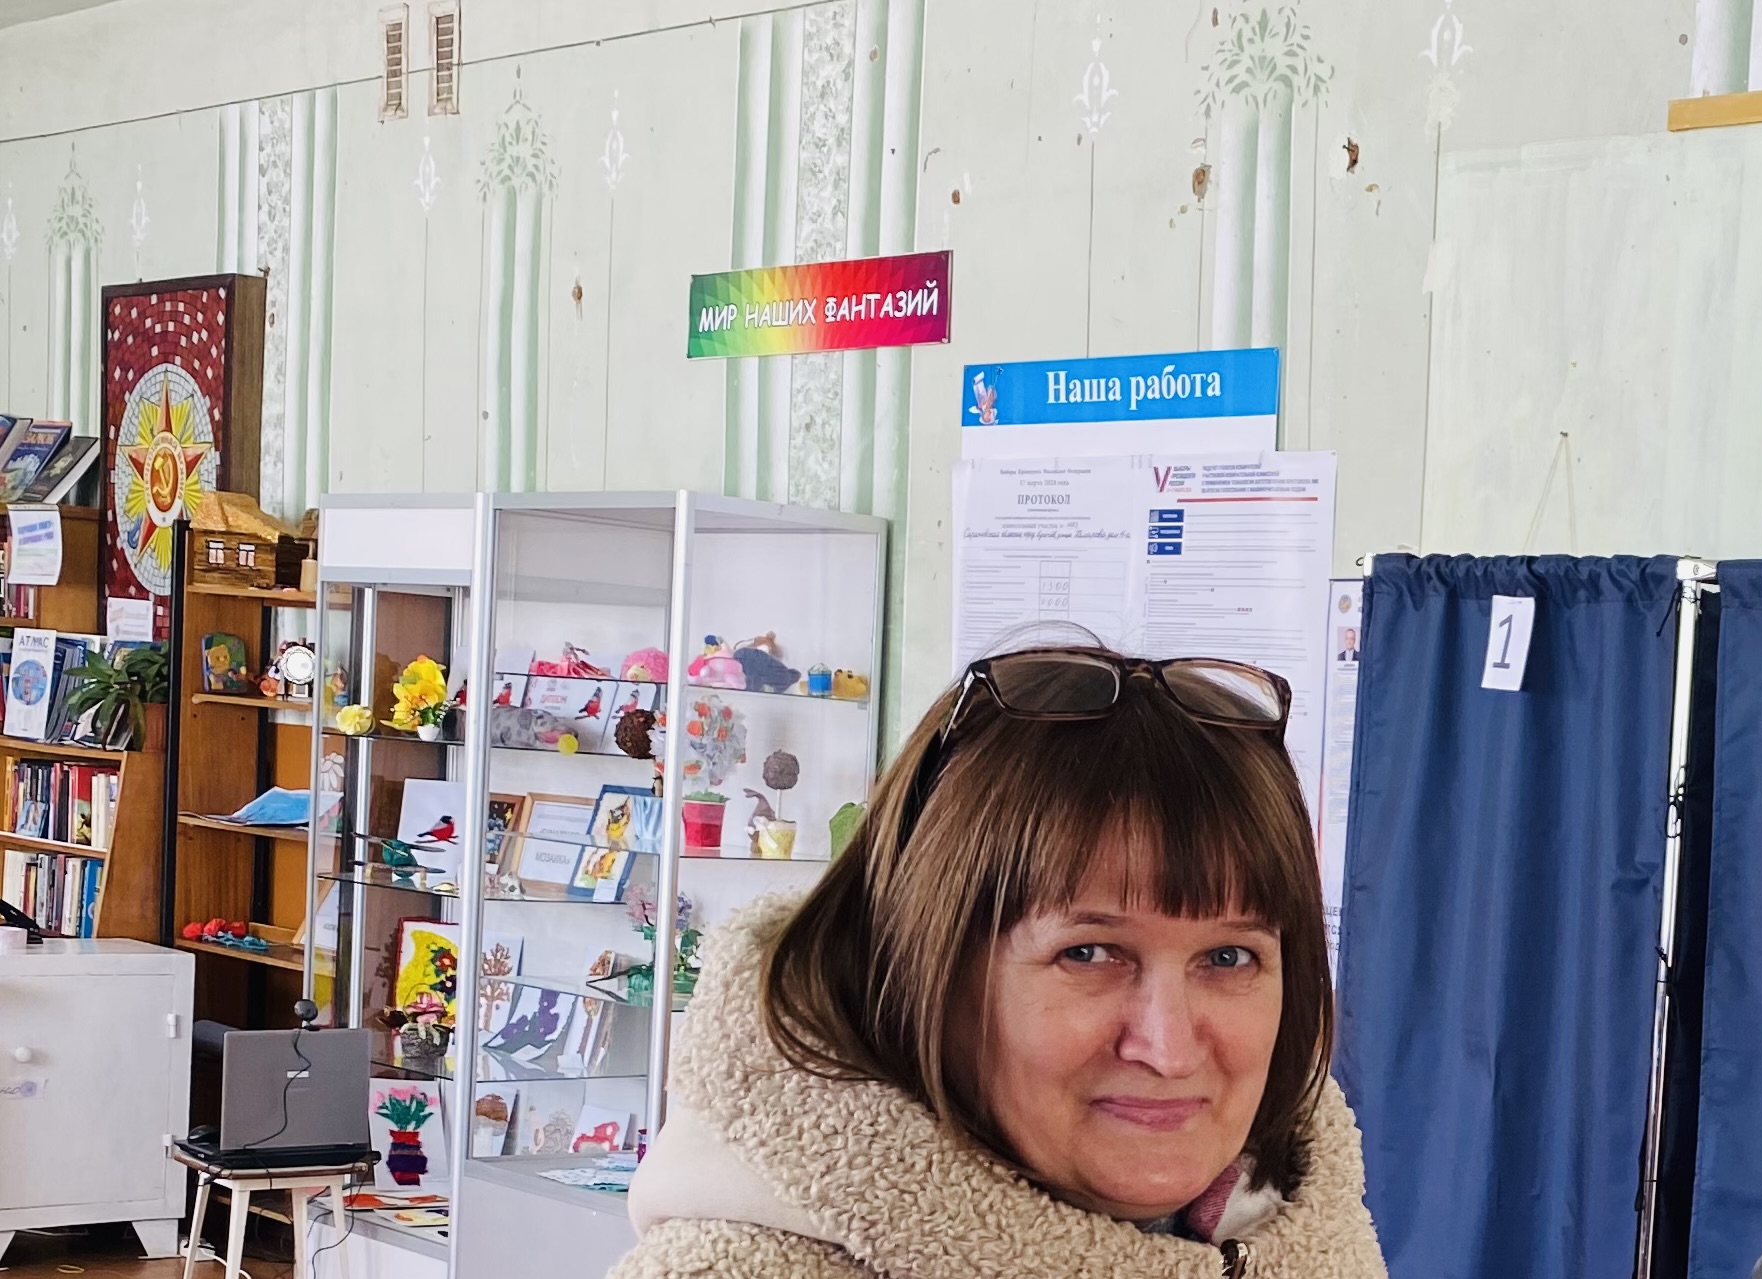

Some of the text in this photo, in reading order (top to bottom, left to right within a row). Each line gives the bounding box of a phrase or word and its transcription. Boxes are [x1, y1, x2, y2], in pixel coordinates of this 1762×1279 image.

[699, 280, 939, 332] МИР НАШИХ ФАНТАЗИЙ
[1045, 364, 1222, 411] Наша работа
[1017, 494, 1071, 505] ПРОТОКОЛ
[1492, 613, 1514, 670] 1
